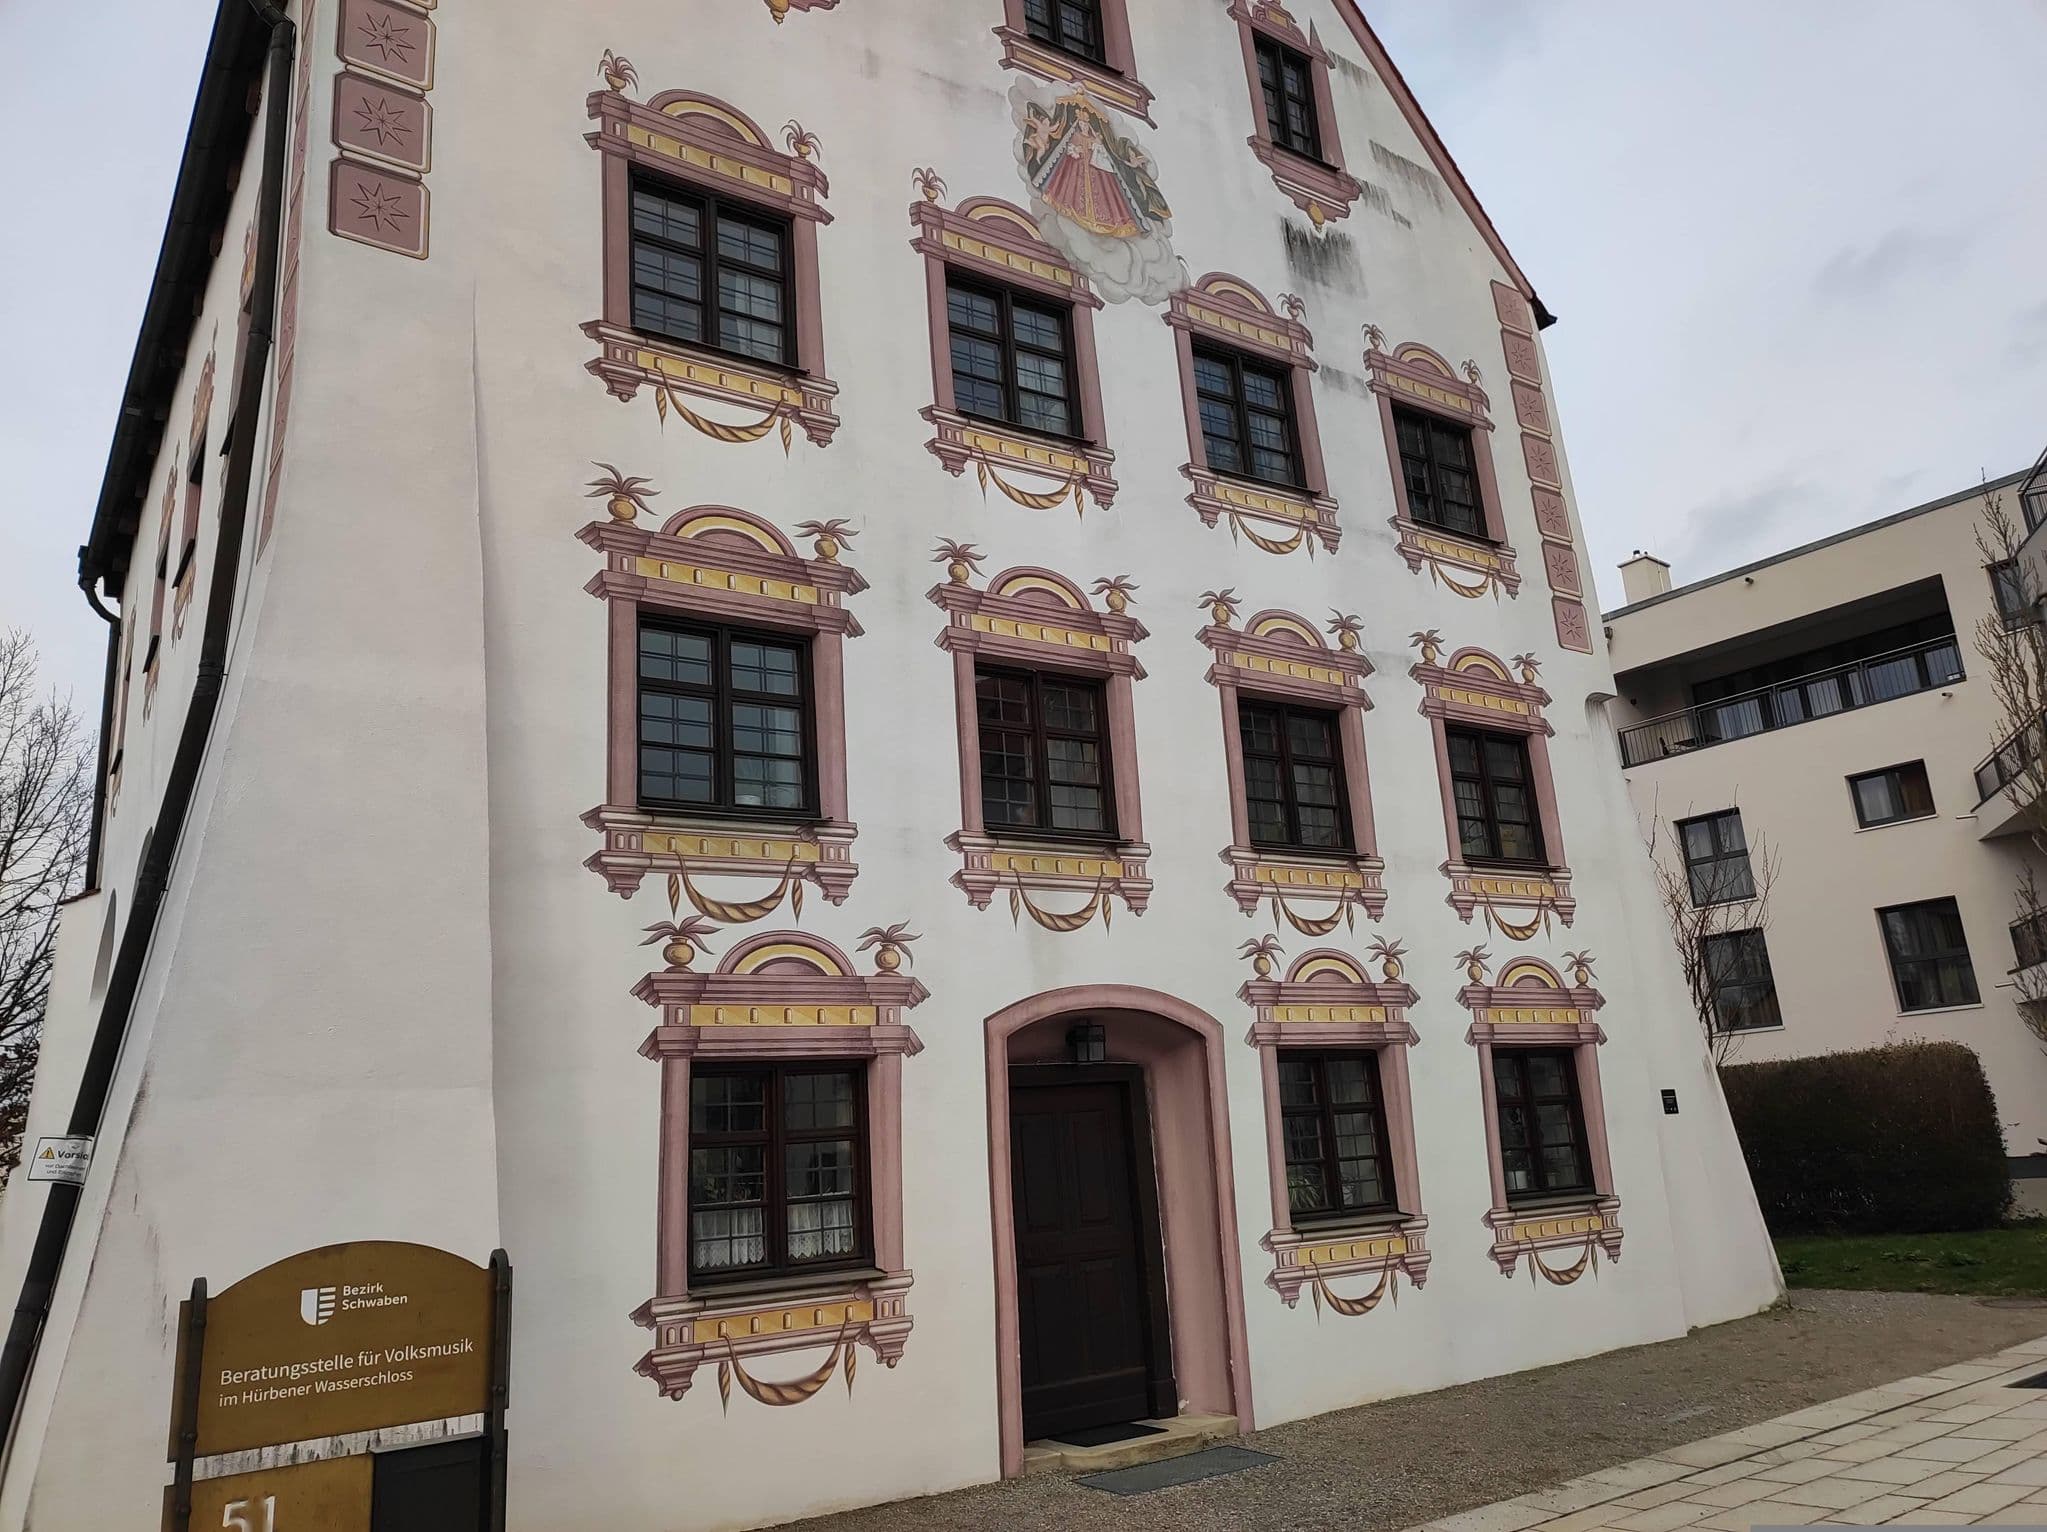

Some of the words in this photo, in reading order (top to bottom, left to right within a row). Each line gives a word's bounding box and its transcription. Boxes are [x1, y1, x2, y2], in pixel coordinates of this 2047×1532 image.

[342, 1282, 384, 1296] Bezirk
[342, 1294, 408, 1310] Schwaben
[220, 1354, 354, 1386] Beratungsstelle
[358, 1350, 381, 1368] für
[384, 1337, 474, 1363] Volksmusik
[218, 1394, 238, 1407] im
[242, 1383, 312, 1404] Hürbener
[314, 1368, 414, 1394] Wasserschloss
[222, 1495, 276, 1532] 51
